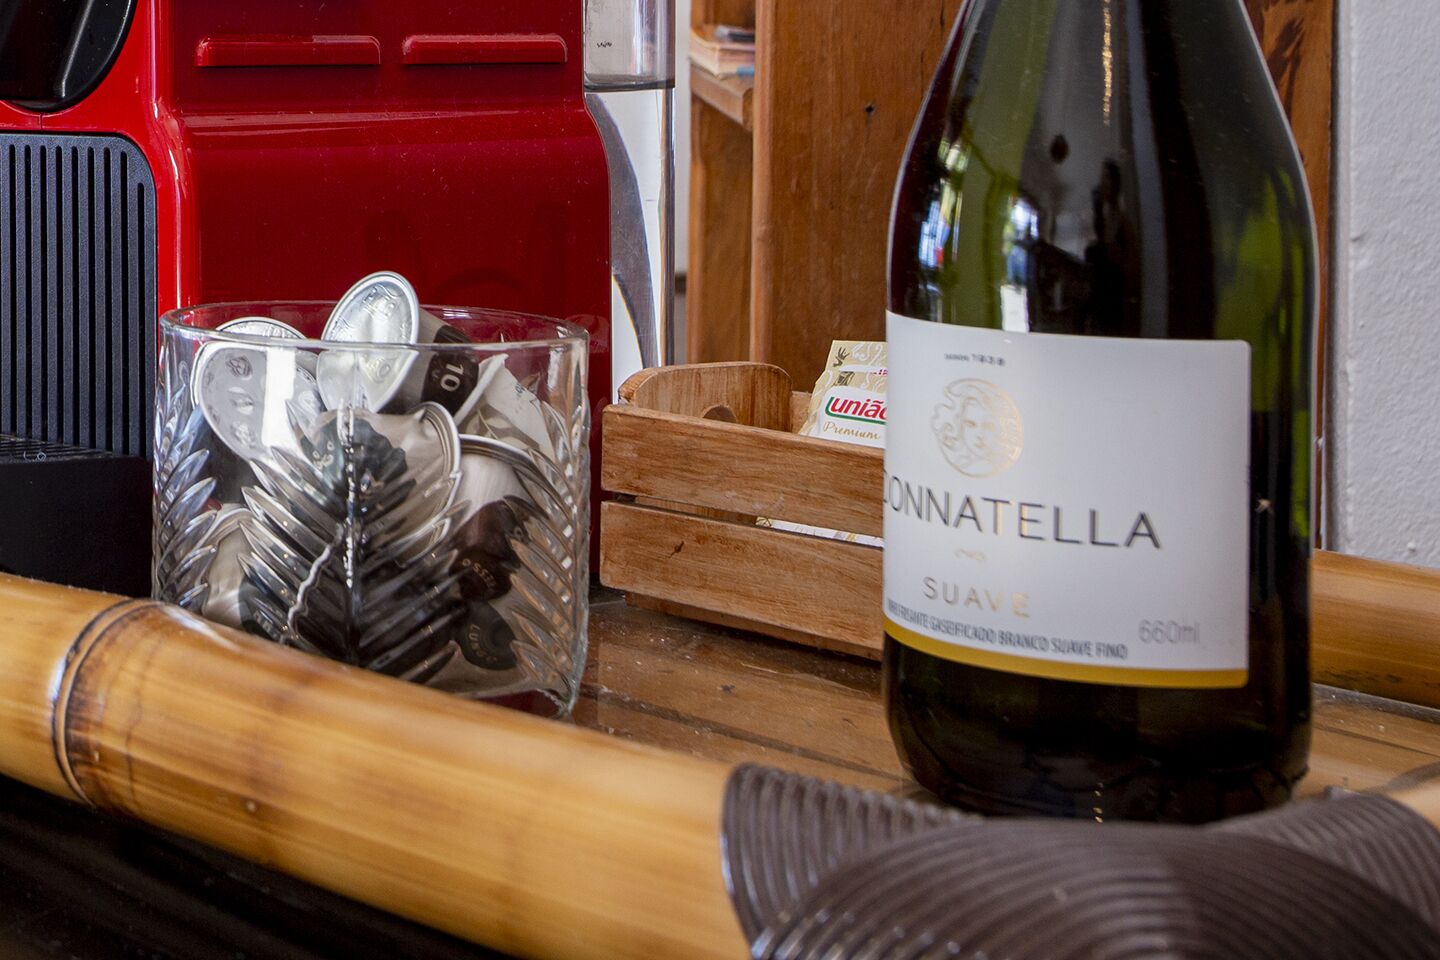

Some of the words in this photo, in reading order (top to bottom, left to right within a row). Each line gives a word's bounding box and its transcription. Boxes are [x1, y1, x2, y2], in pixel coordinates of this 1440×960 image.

[440, 363, 464, 391] 10
[923, 576, 1032, 619] SUAVE
[998, 630, 1049, 652] BRANCO
[1051, 638, 1093, 659] SUAVE
[1096, 642, 1128, 660] FINO
